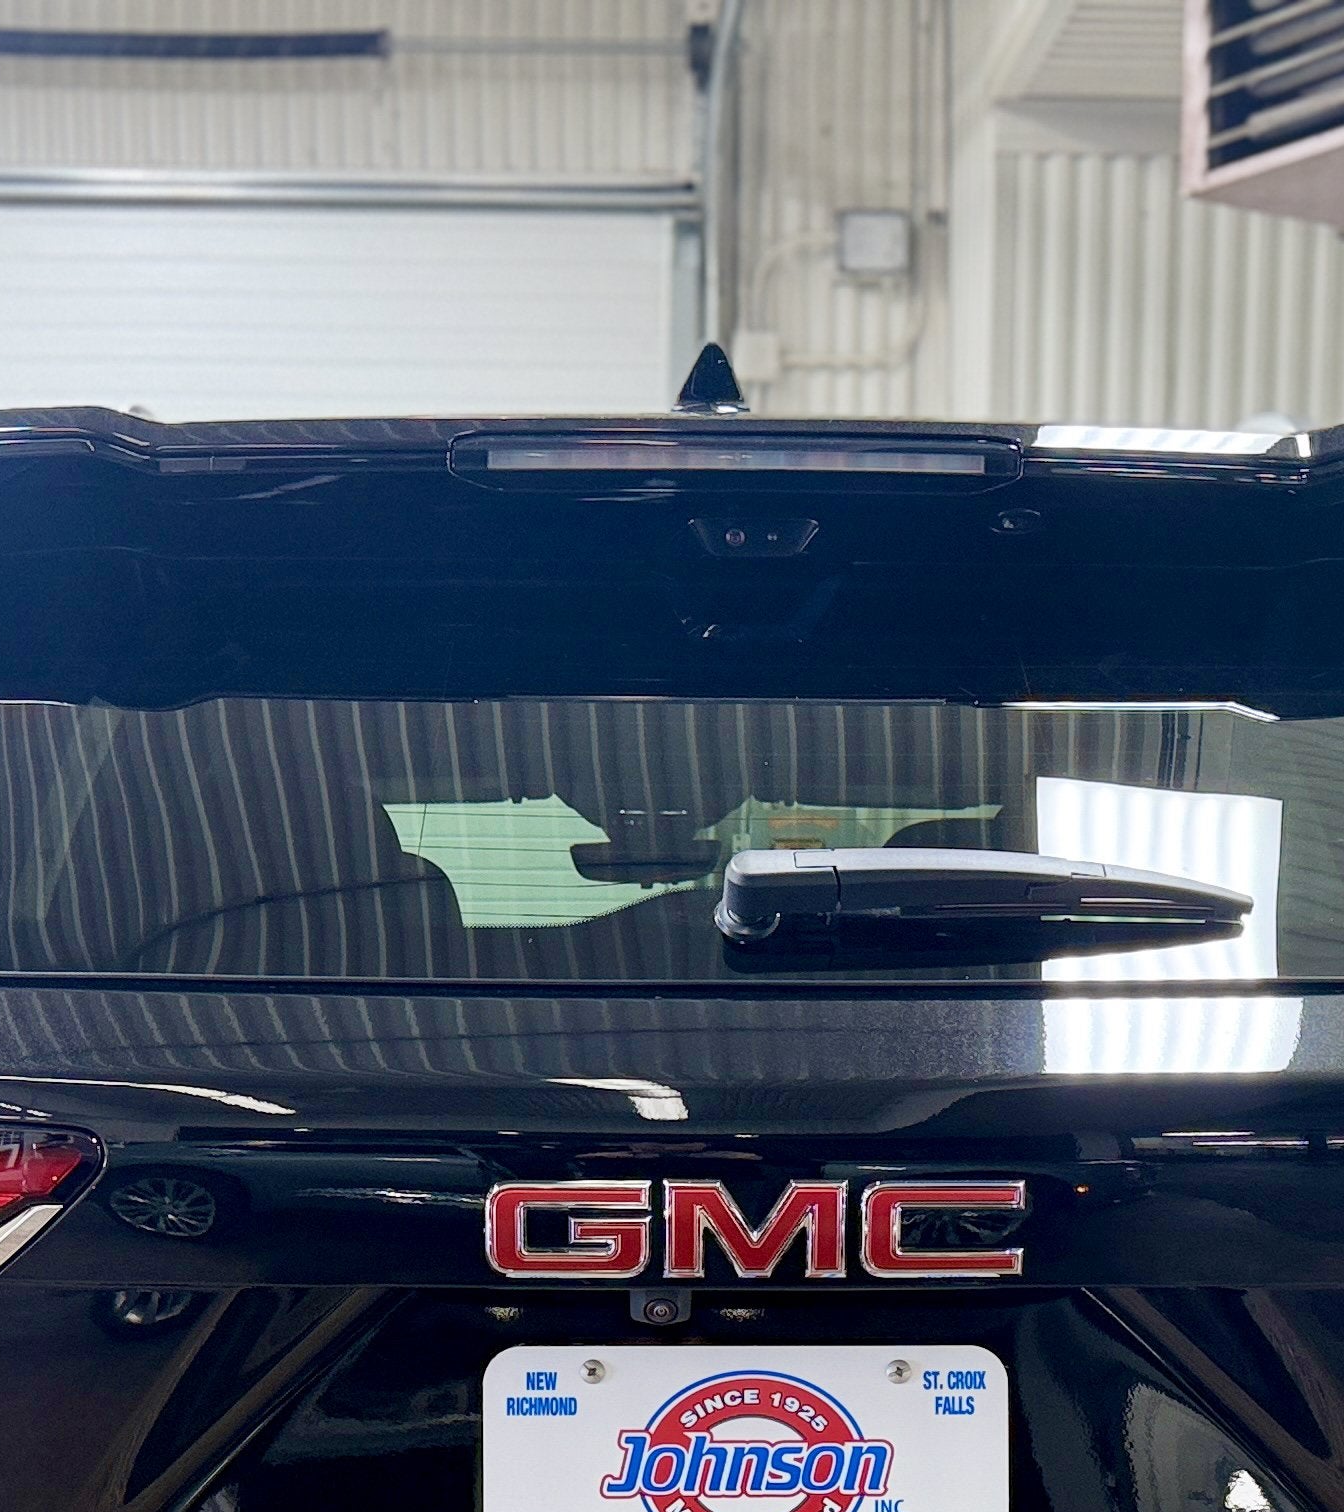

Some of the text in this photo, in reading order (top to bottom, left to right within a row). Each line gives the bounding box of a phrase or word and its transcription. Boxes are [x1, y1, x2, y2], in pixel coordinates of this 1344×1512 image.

[485, 1179, 1026, 1278] GMC
[526, 1372, 557, 1390] NEW
[923, 1371, 986, 1390] ST. CROIX
[506, 1397, 577, 1416] RICHMOND
[679, 1388, 828, 1432] SINCE 1925
[935, 1396, 974, 1415] FALLS
[606, 1434, 887, 1493] Johnson
